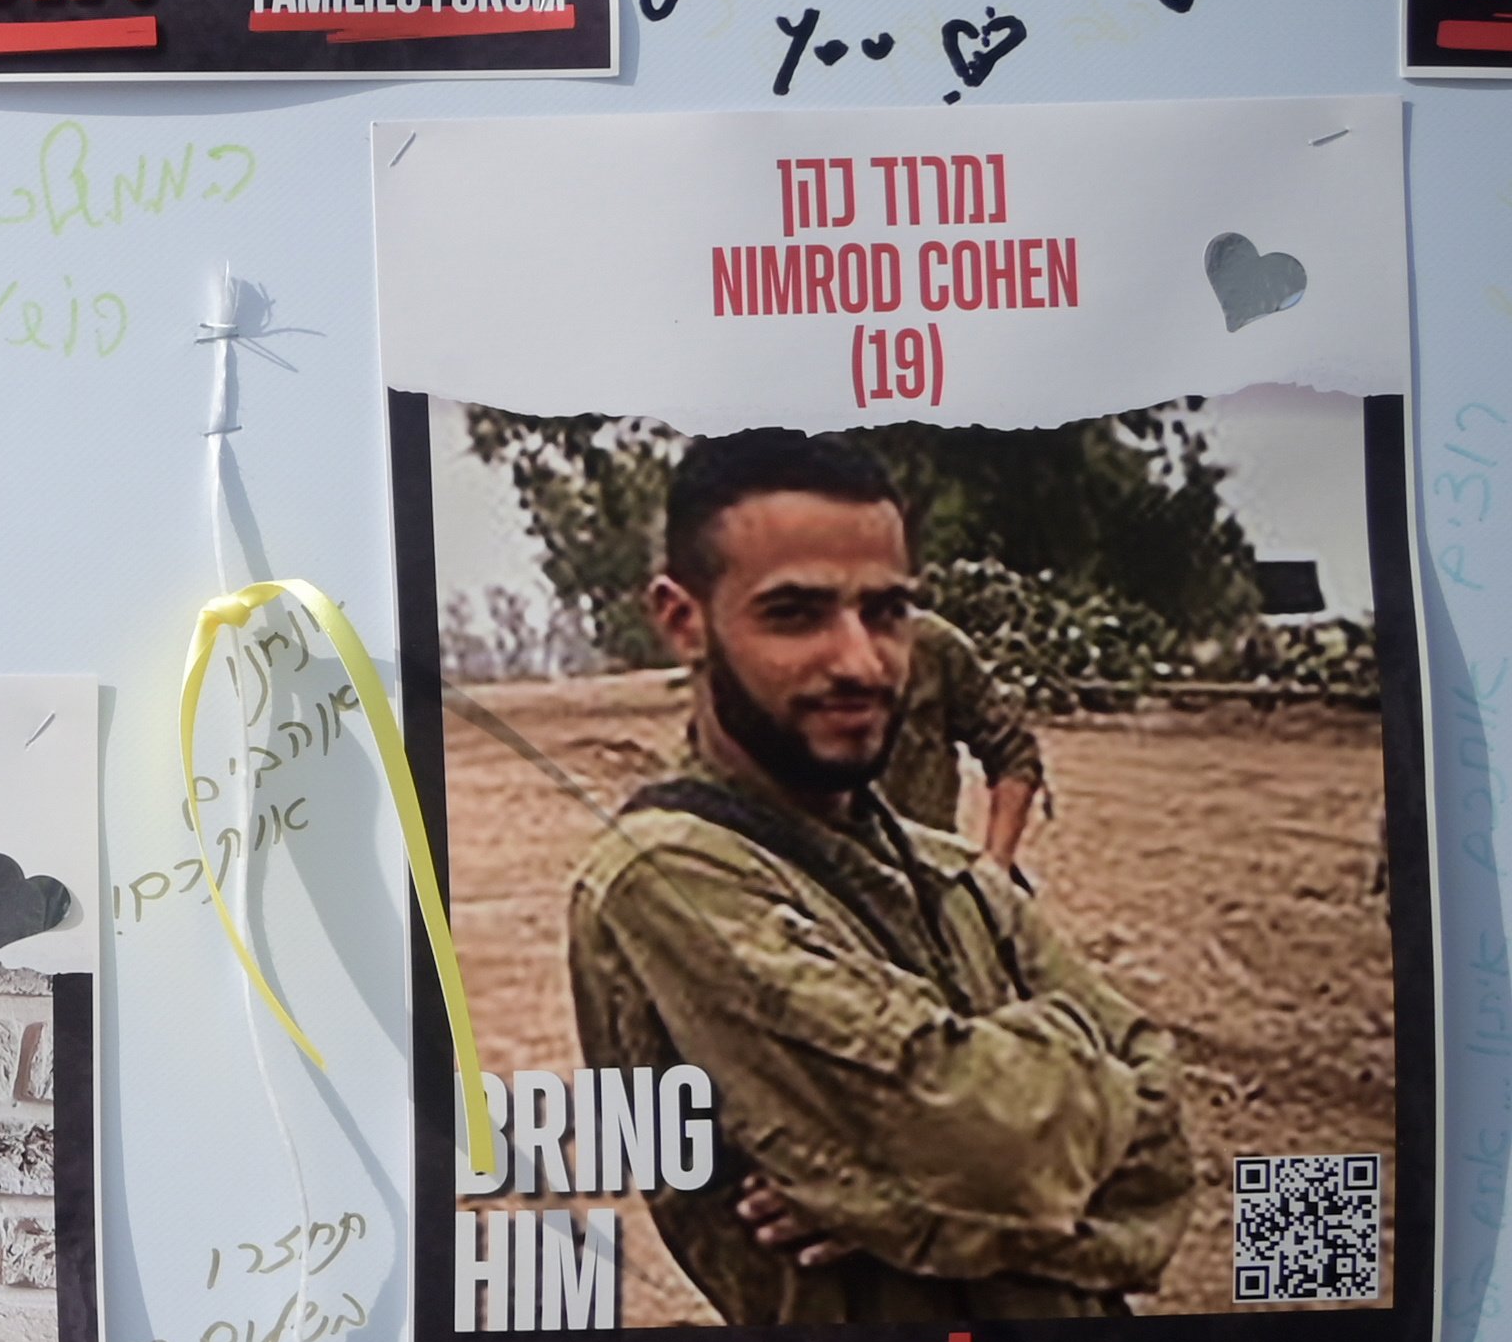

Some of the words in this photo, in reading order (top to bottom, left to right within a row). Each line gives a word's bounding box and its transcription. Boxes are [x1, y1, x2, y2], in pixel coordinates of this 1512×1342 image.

[779, 158, 856, 236] כהן
[872, 154, 1007, 226] נמרוד
[714, 243, 902, 316] NIMROD
[920, 238, 1079, 311] COHEN
[854, 323, 944, 408] (19)
